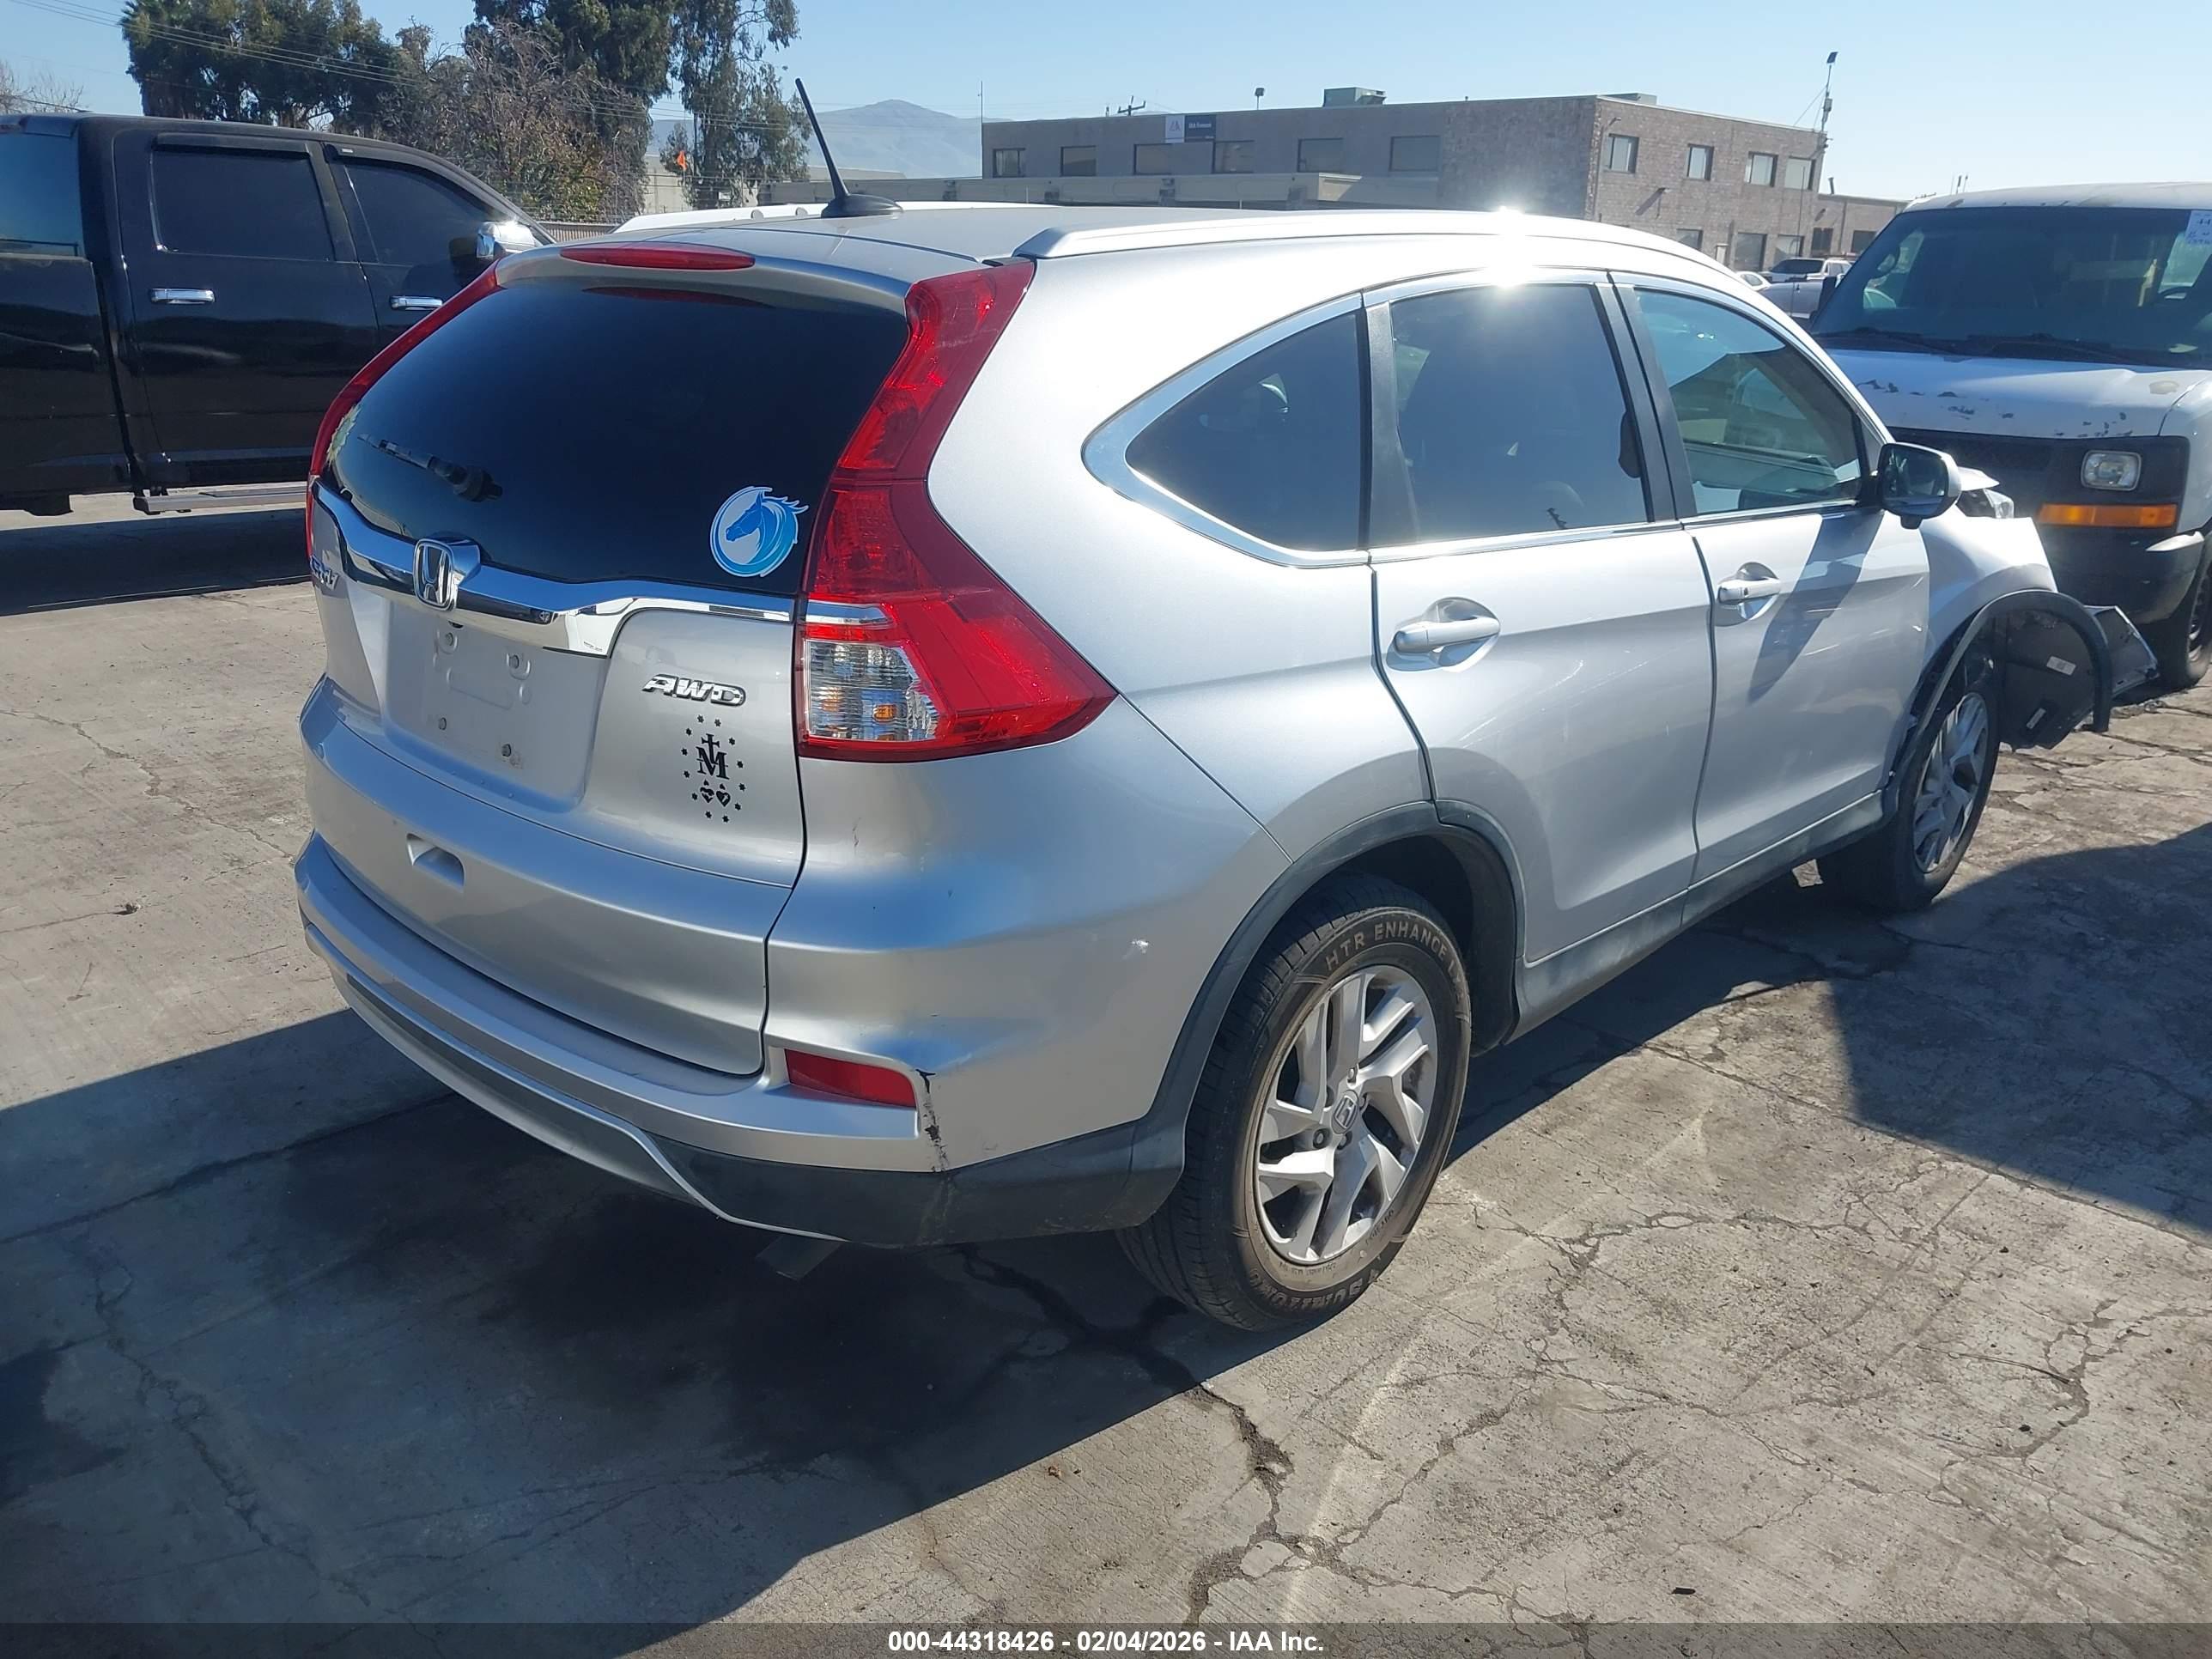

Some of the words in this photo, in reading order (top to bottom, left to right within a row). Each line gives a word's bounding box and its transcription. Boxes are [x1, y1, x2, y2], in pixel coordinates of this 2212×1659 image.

[642, 673, 746, 707] AWD
[1325, 932, 1366, 971] HTR
[1374, 921, 1448, 961] ENHANCE
